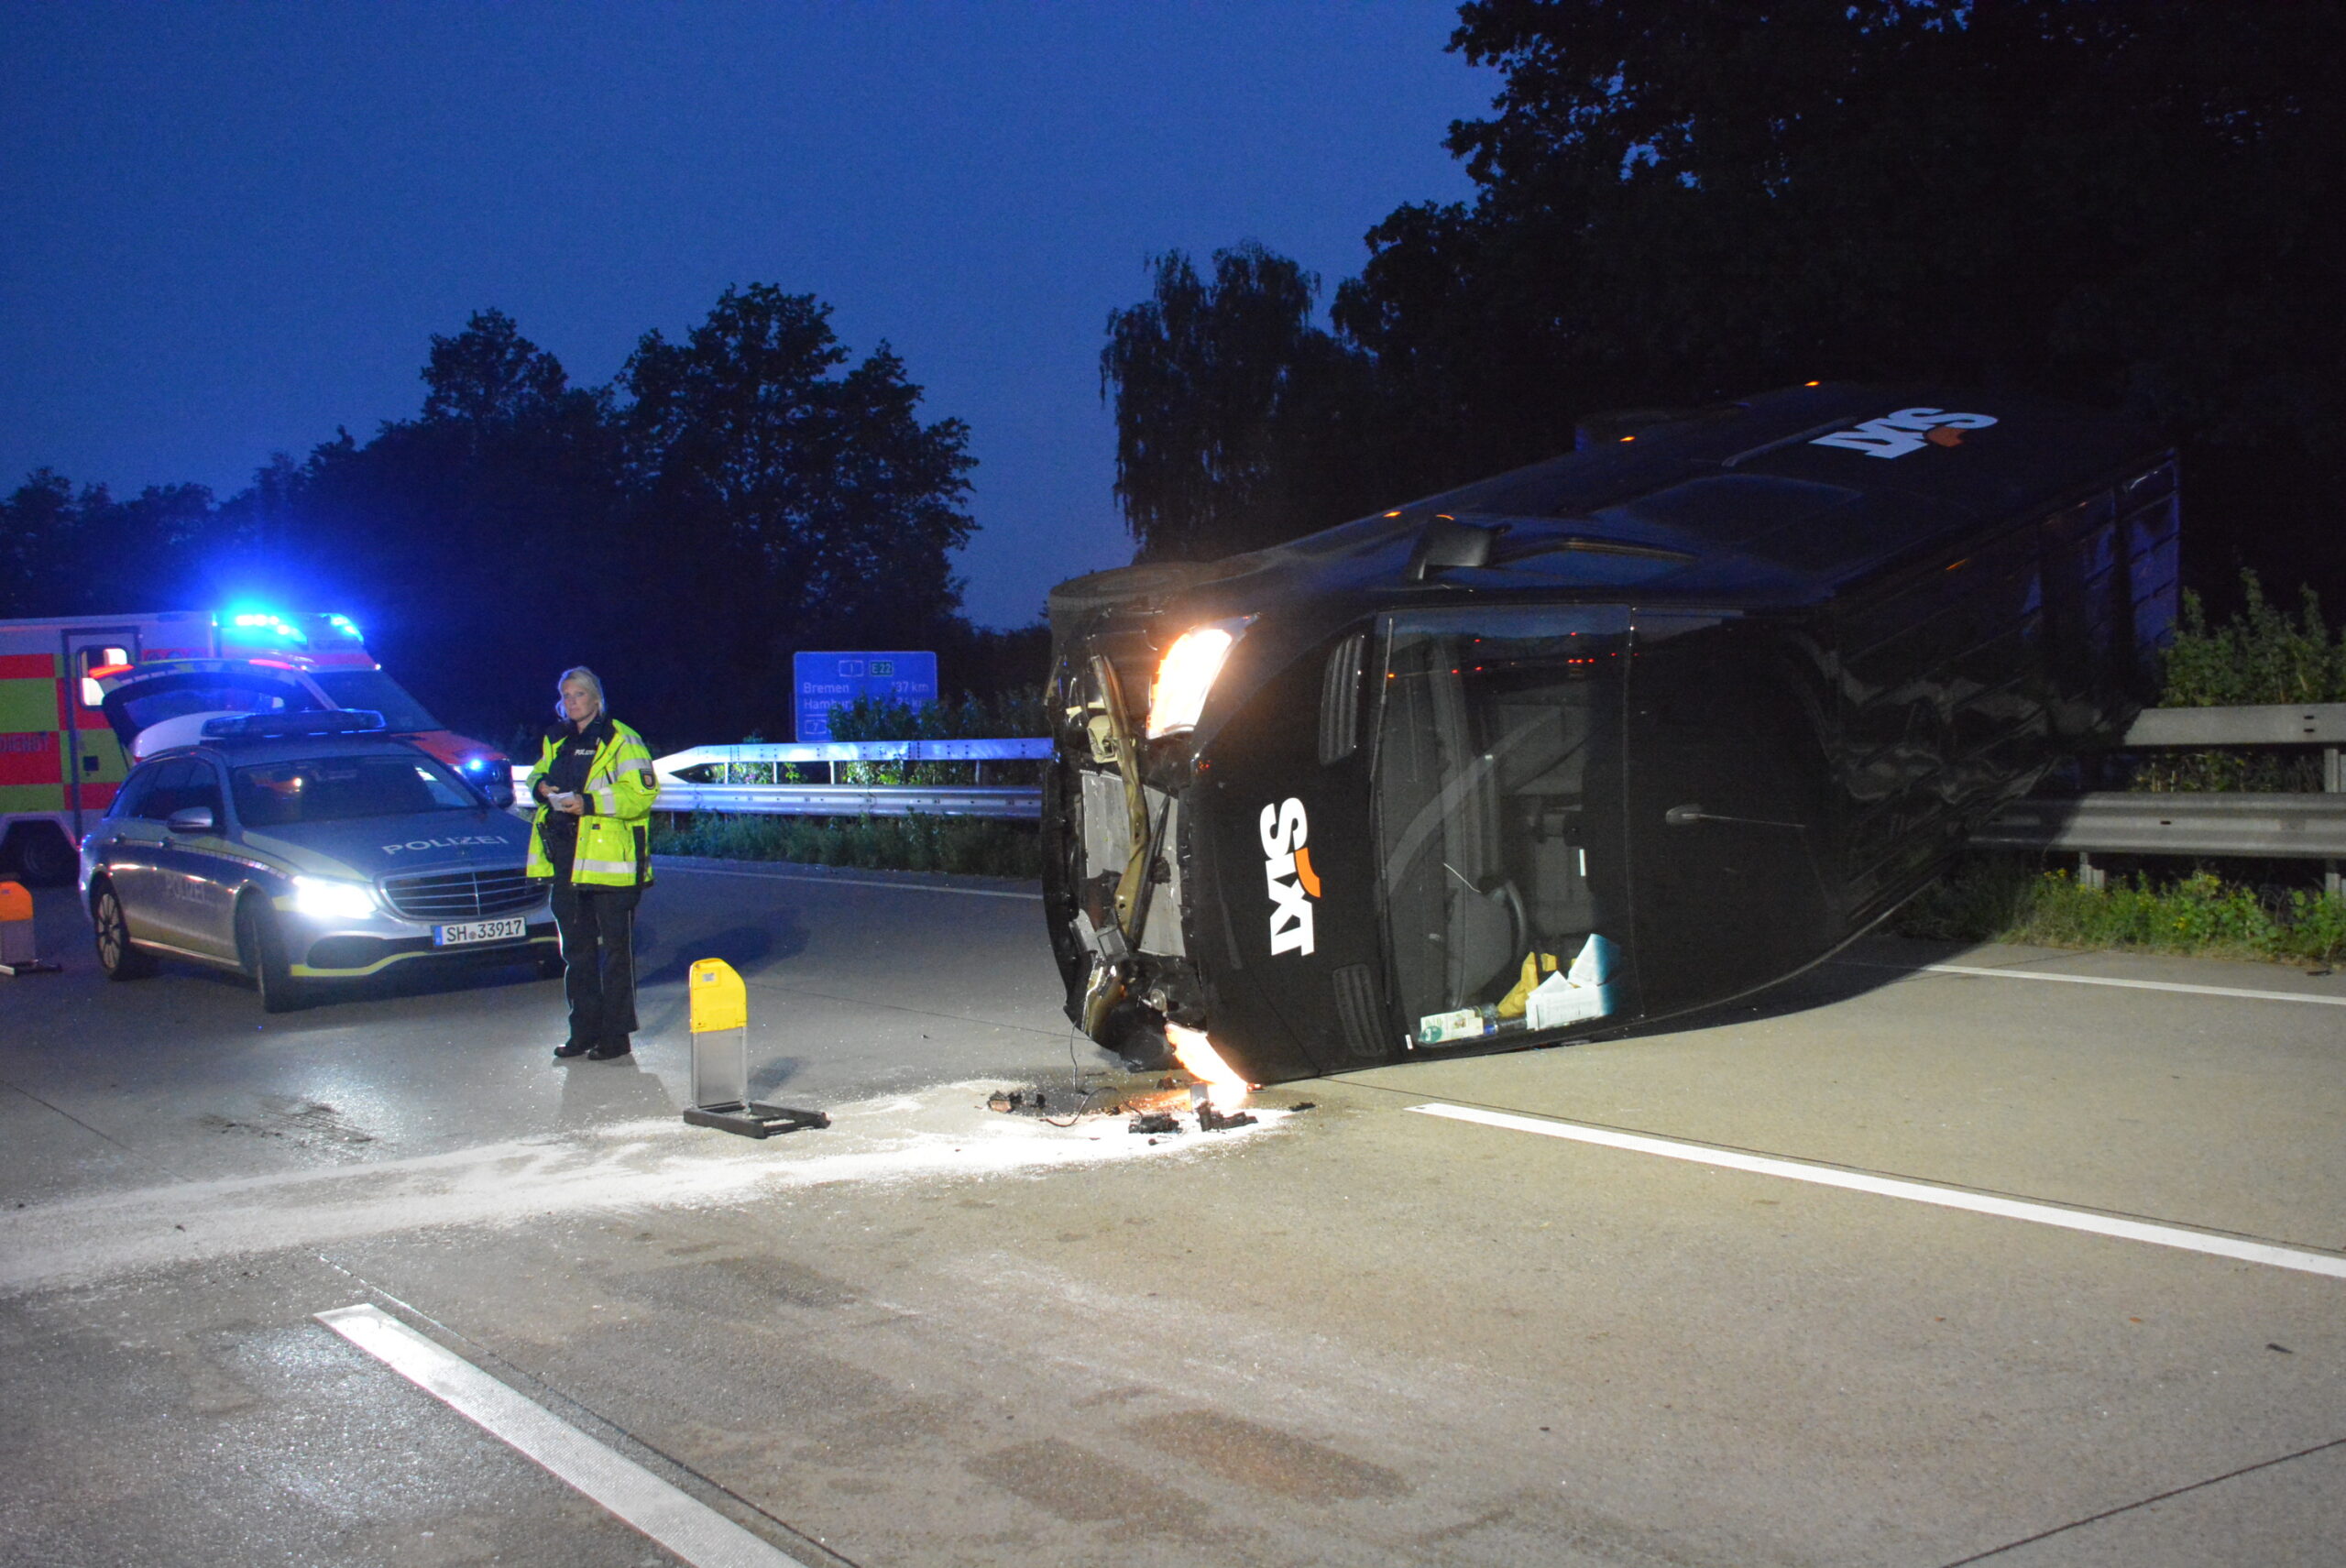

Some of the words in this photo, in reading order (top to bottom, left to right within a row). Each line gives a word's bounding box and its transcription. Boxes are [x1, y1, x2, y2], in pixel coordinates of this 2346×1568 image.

[1808, 407, 1999, 460] SIXT
[804, 682, 850, 694] Bremen
[912, 681, 929, 693] km
[381, 835, 510, 856] POLIZEI
[1259, 797, 1321, 957] SIXT
[477, 919, 523, 939] 33917
